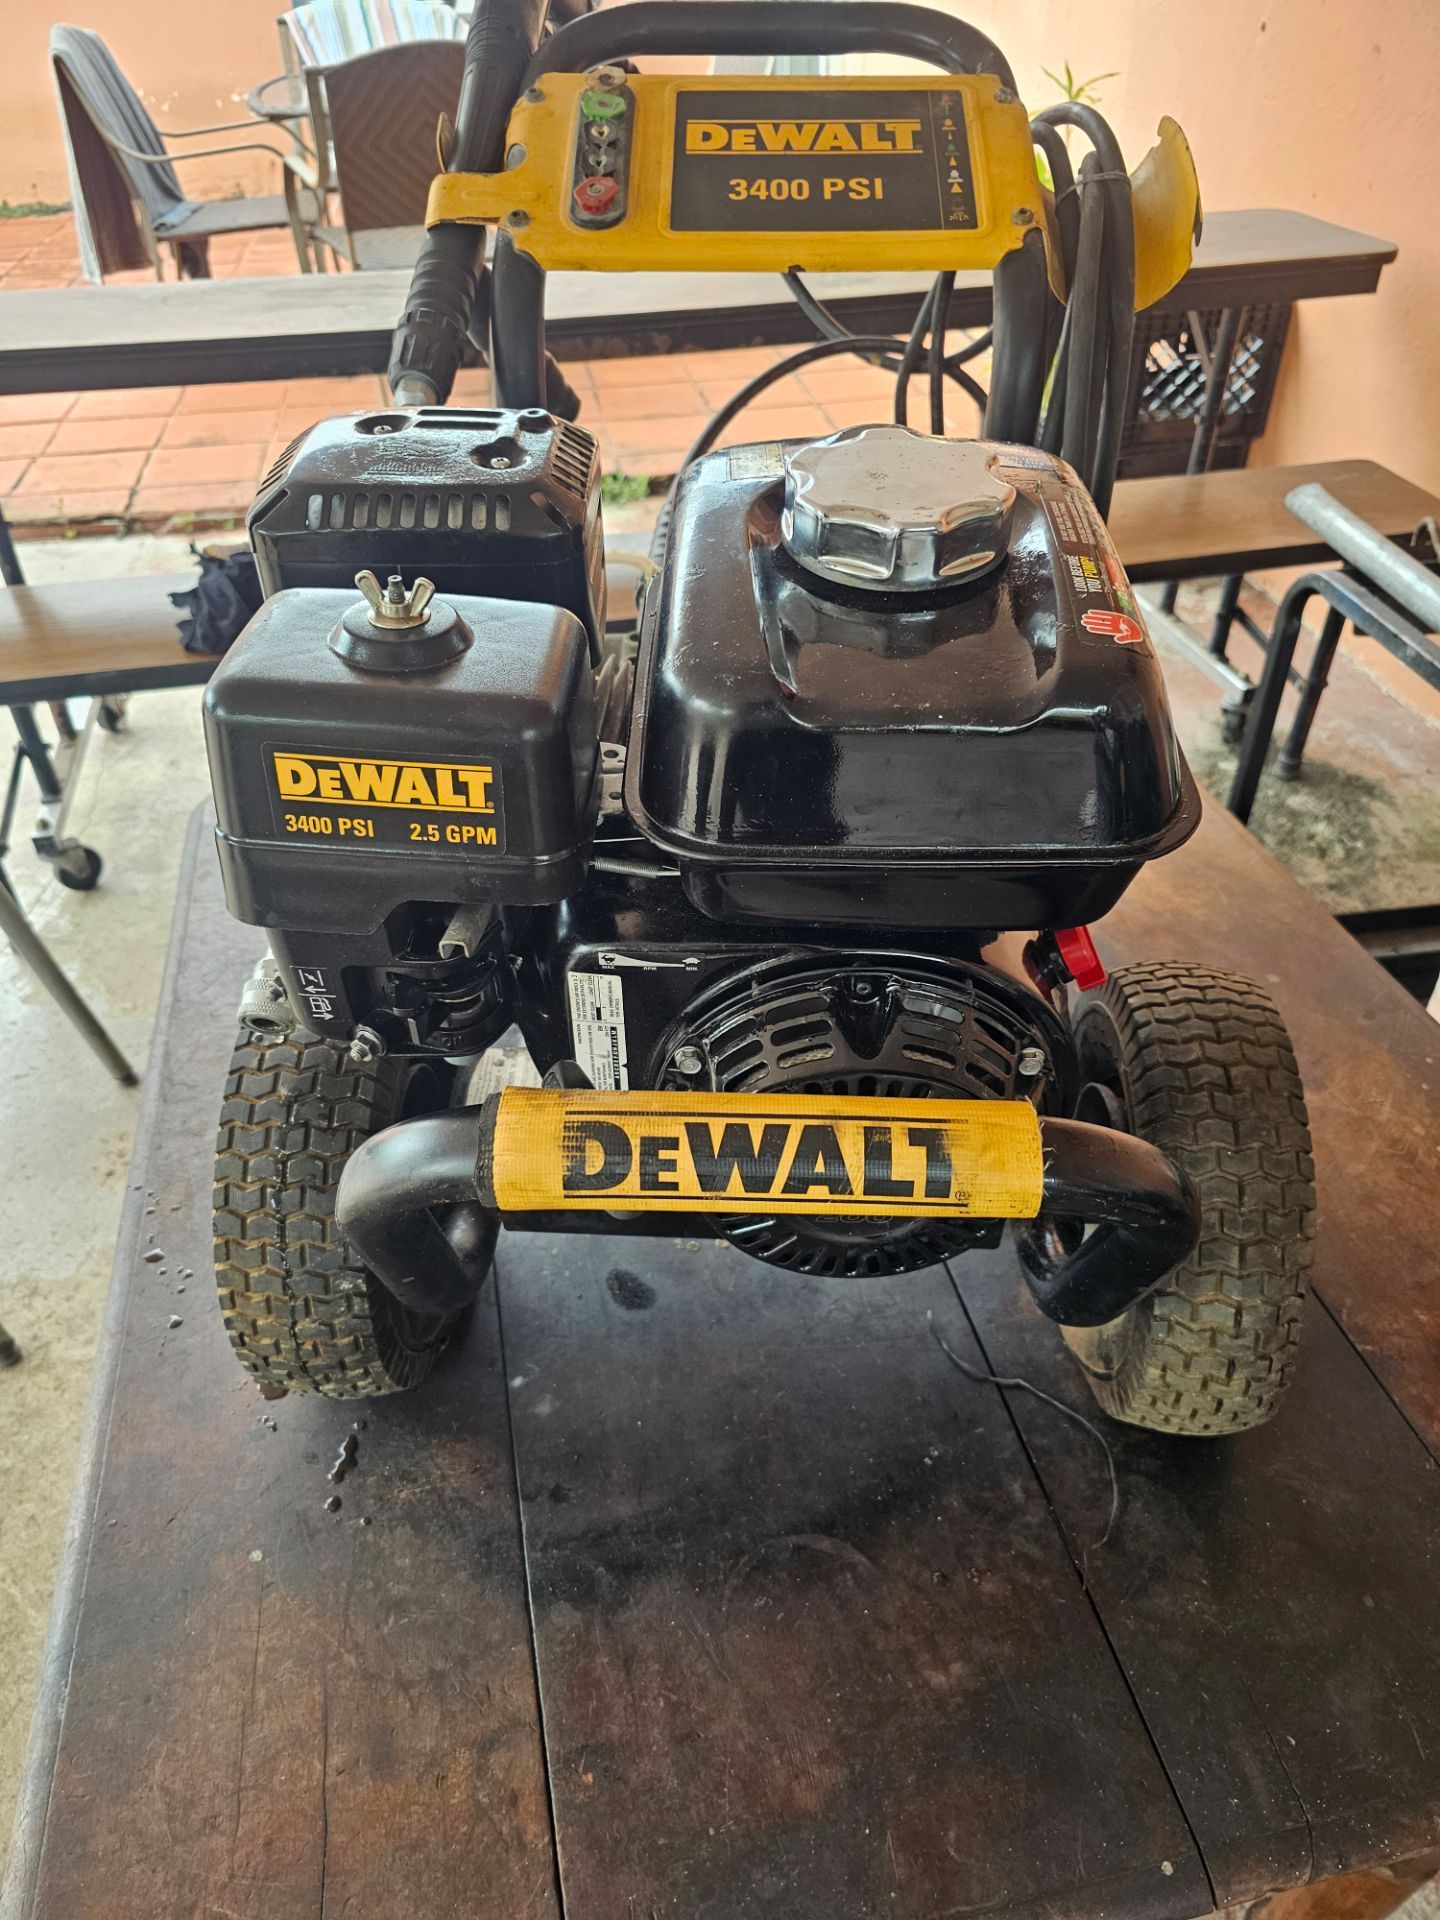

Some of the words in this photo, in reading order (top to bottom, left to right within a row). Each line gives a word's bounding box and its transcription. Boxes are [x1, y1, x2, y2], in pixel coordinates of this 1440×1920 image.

[728, 178, 810, 200] 3400
[822, 177, 883, 200] PSI
[1067, 555, 1084, 576] BEFORE
[1072, 576, 1087, 592] LOOK
[1086, 578, 1102, 592] YOU
[284, 814, 332, 835] 3400
[337, 817, 375, 838] PSI
[409, 823, 440, 842] 2.5
[445, 825, 497, 846] GPM
